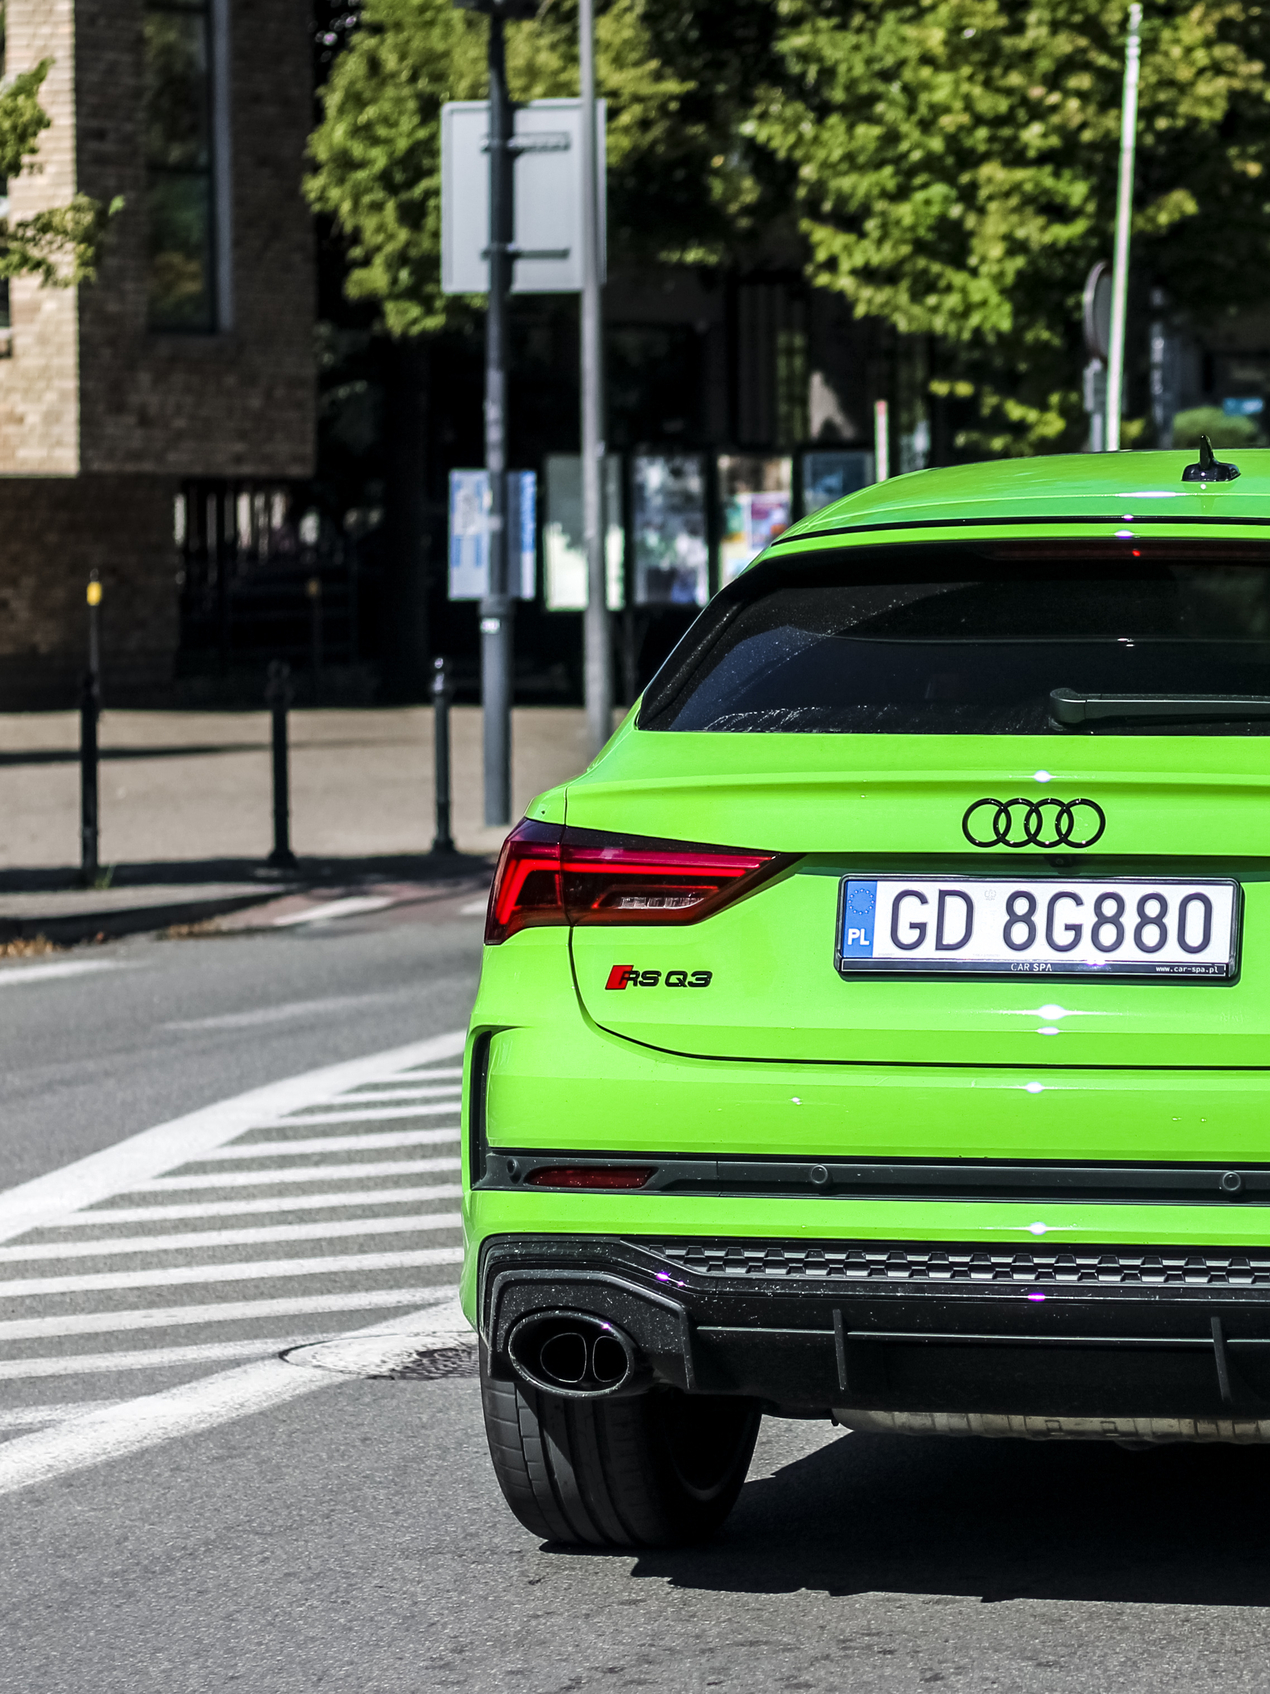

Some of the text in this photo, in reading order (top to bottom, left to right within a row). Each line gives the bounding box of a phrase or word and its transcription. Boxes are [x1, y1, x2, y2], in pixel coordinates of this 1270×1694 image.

[890, 888, 1213, 954] GD 8G880
[847, 928, 870, 946] PL
[1011, 962, 1053, 972] CAR SPA
[1156, 963, 1219, 974] www.car-spa.pl
[619, 970, 713, 988] RS Q3
